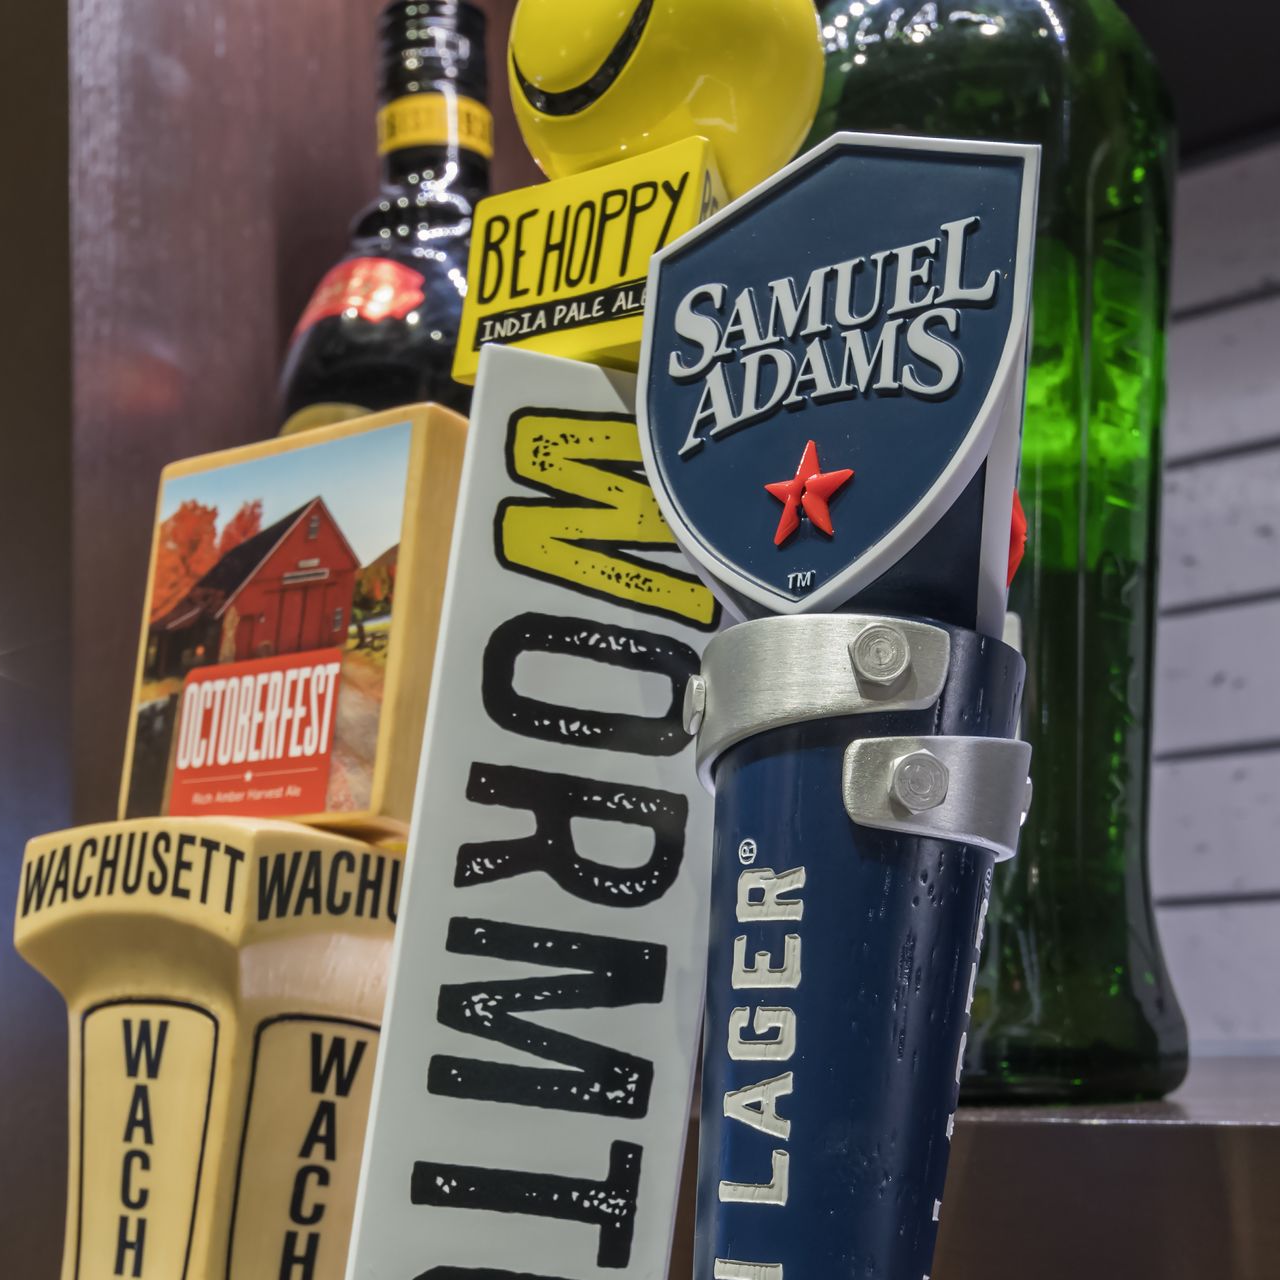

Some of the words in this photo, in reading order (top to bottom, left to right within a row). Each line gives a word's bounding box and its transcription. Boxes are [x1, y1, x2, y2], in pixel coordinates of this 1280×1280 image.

[479, 309, 547, 342] INDIA
[552, 296, 606, 327] PALE
[668, 216, 1000, 379] SAMUEL
[678, 308, 964, 457] ADAMS
[175, 662, 342, 770] OCTOBERFEST
[21, 830, 246, 919] WACHUSETT
[718, 864, 808, 1207] LAGER
